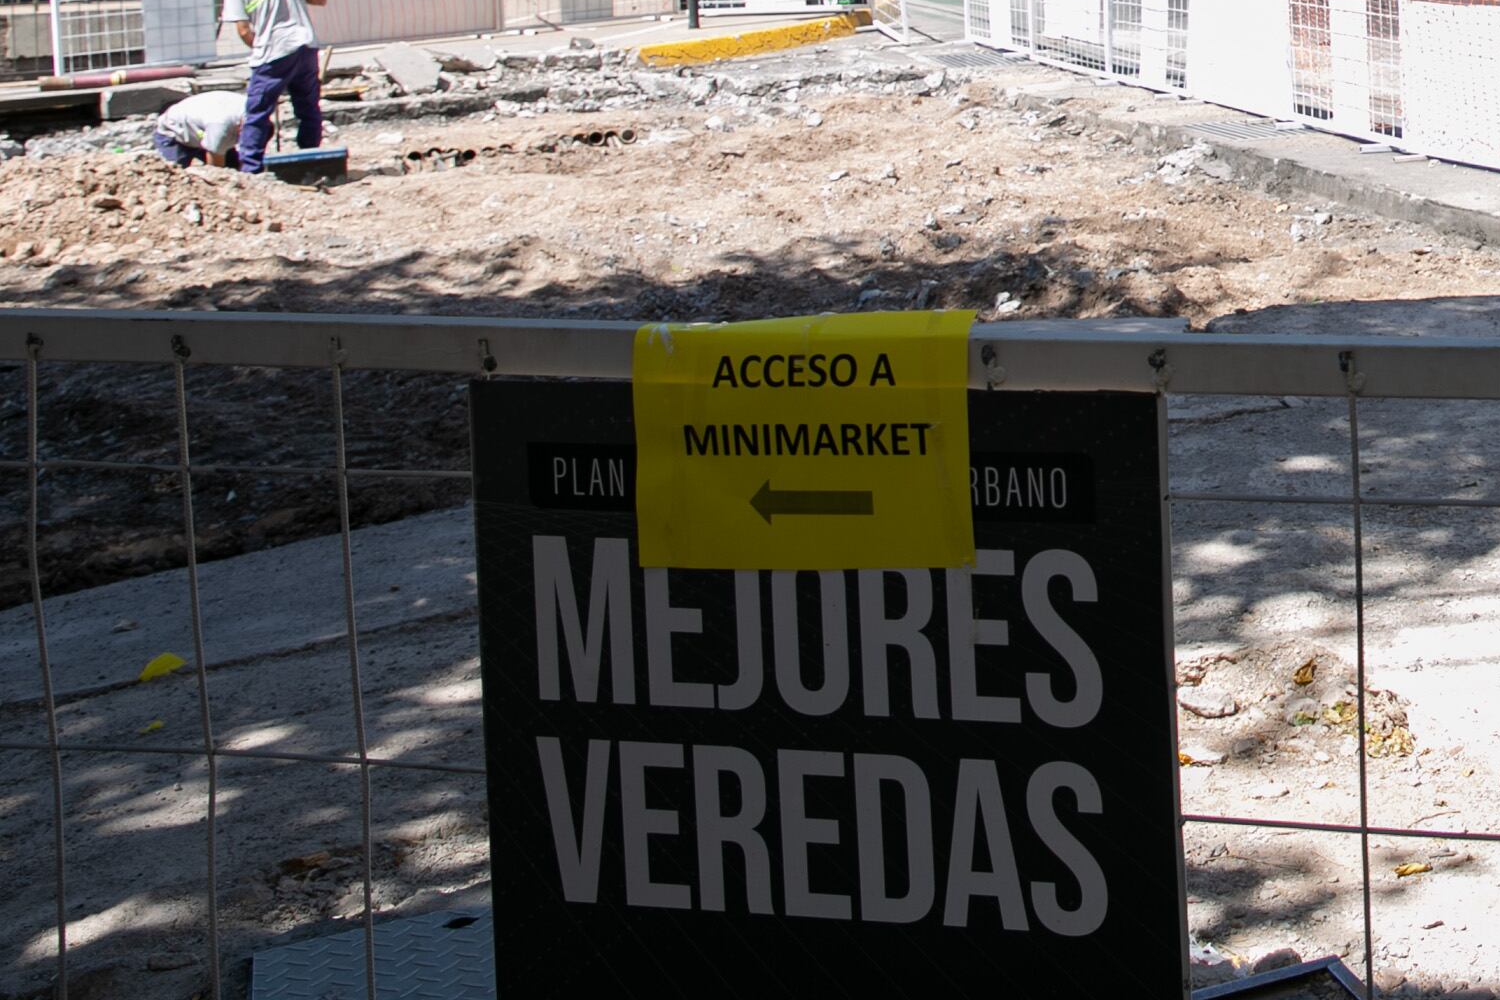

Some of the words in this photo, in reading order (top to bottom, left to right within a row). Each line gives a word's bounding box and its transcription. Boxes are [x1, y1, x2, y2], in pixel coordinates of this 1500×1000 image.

[712, 354, 858, 389] ACCESO
[869, 353, 896, 387] A
[683, 423, 931, 456] MINIMARKET
[553, 456, 625, 497] PLAN
[969, 466, 1067, 509] RBANO
[531, 535, 1103, 728] MEJORES
[535, 736, 1109, 937] VEREDAS
